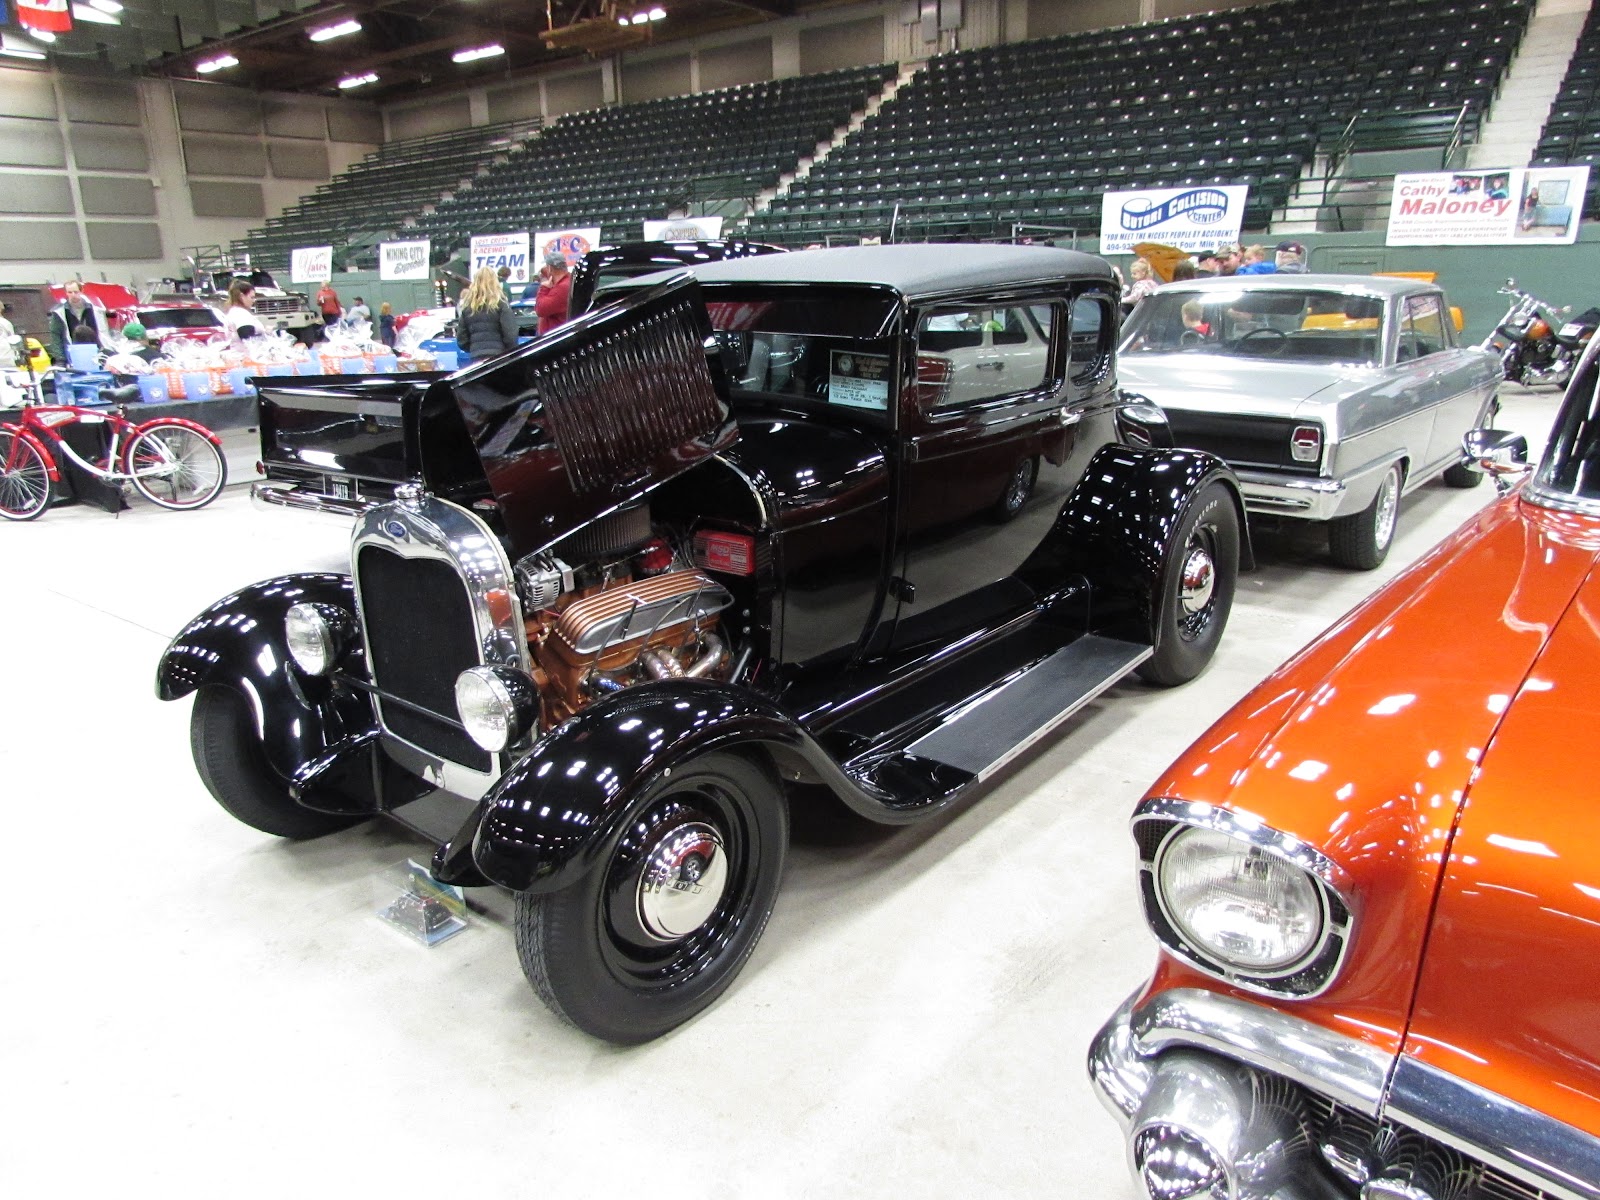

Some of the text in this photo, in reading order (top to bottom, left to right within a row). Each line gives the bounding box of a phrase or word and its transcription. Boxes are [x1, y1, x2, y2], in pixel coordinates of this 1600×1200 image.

[1400, 185, 1445, 197] Cathy
[1168, 191, 1227, 217] COLLISION
[1399, 198, 1513, 217] Maloney
[1193, 211, 1222, 223] CENTER
[1120, 232, 1134, 240] MEET
[1136, 231, 1147, 240] THE
[1147, 231, 1169, 240] NICEST
[1170, 230, 1191, 239] PEOPLE
[1193, 229, 1201, 238] BY
[473, 246, 507, 255] RACEWAY
[1180, 241, 1196, 249] Four
[1200, 240, 1215, 249] Mile
[386, 246, 425, 262] MINING CITY
[476, 253, 525, 269] TEAM
